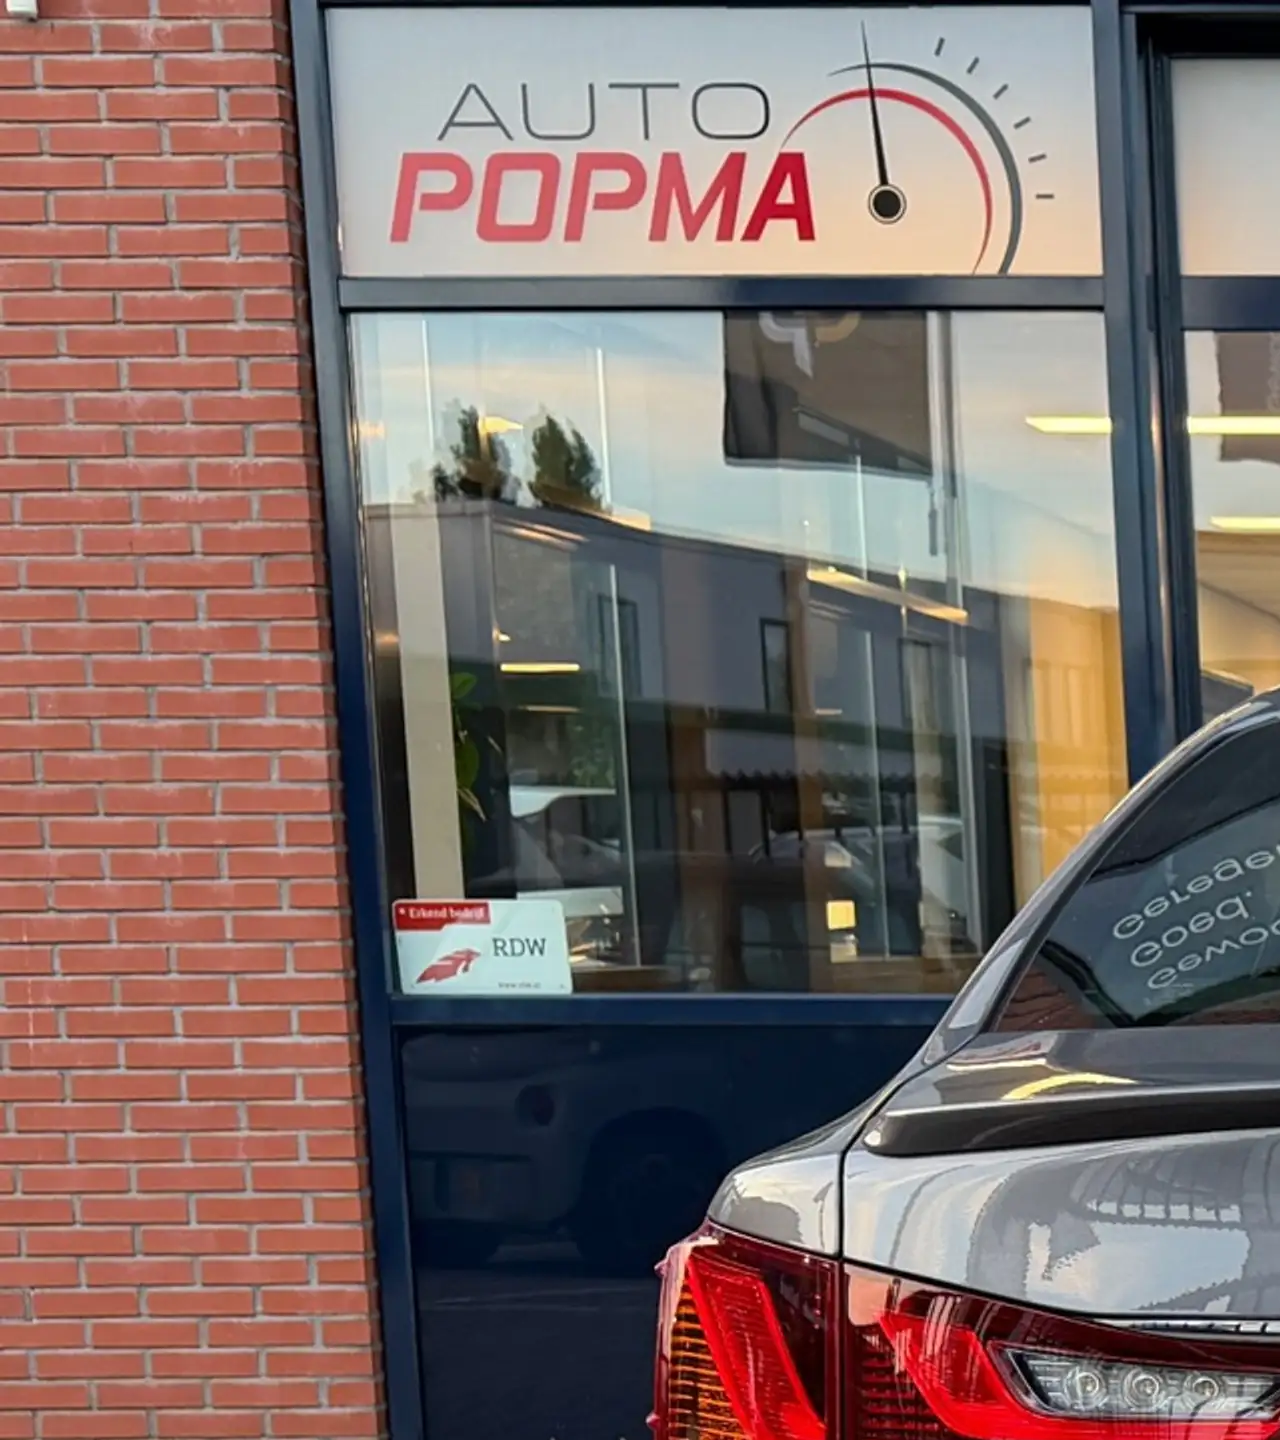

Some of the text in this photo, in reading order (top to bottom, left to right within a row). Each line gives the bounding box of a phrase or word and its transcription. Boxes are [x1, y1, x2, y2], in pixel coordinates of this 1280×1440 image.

[436, 82, 771, 142] AUTO
[389, 151, 816, 243] POPMA
[492, 938, 547, 957] RDW
